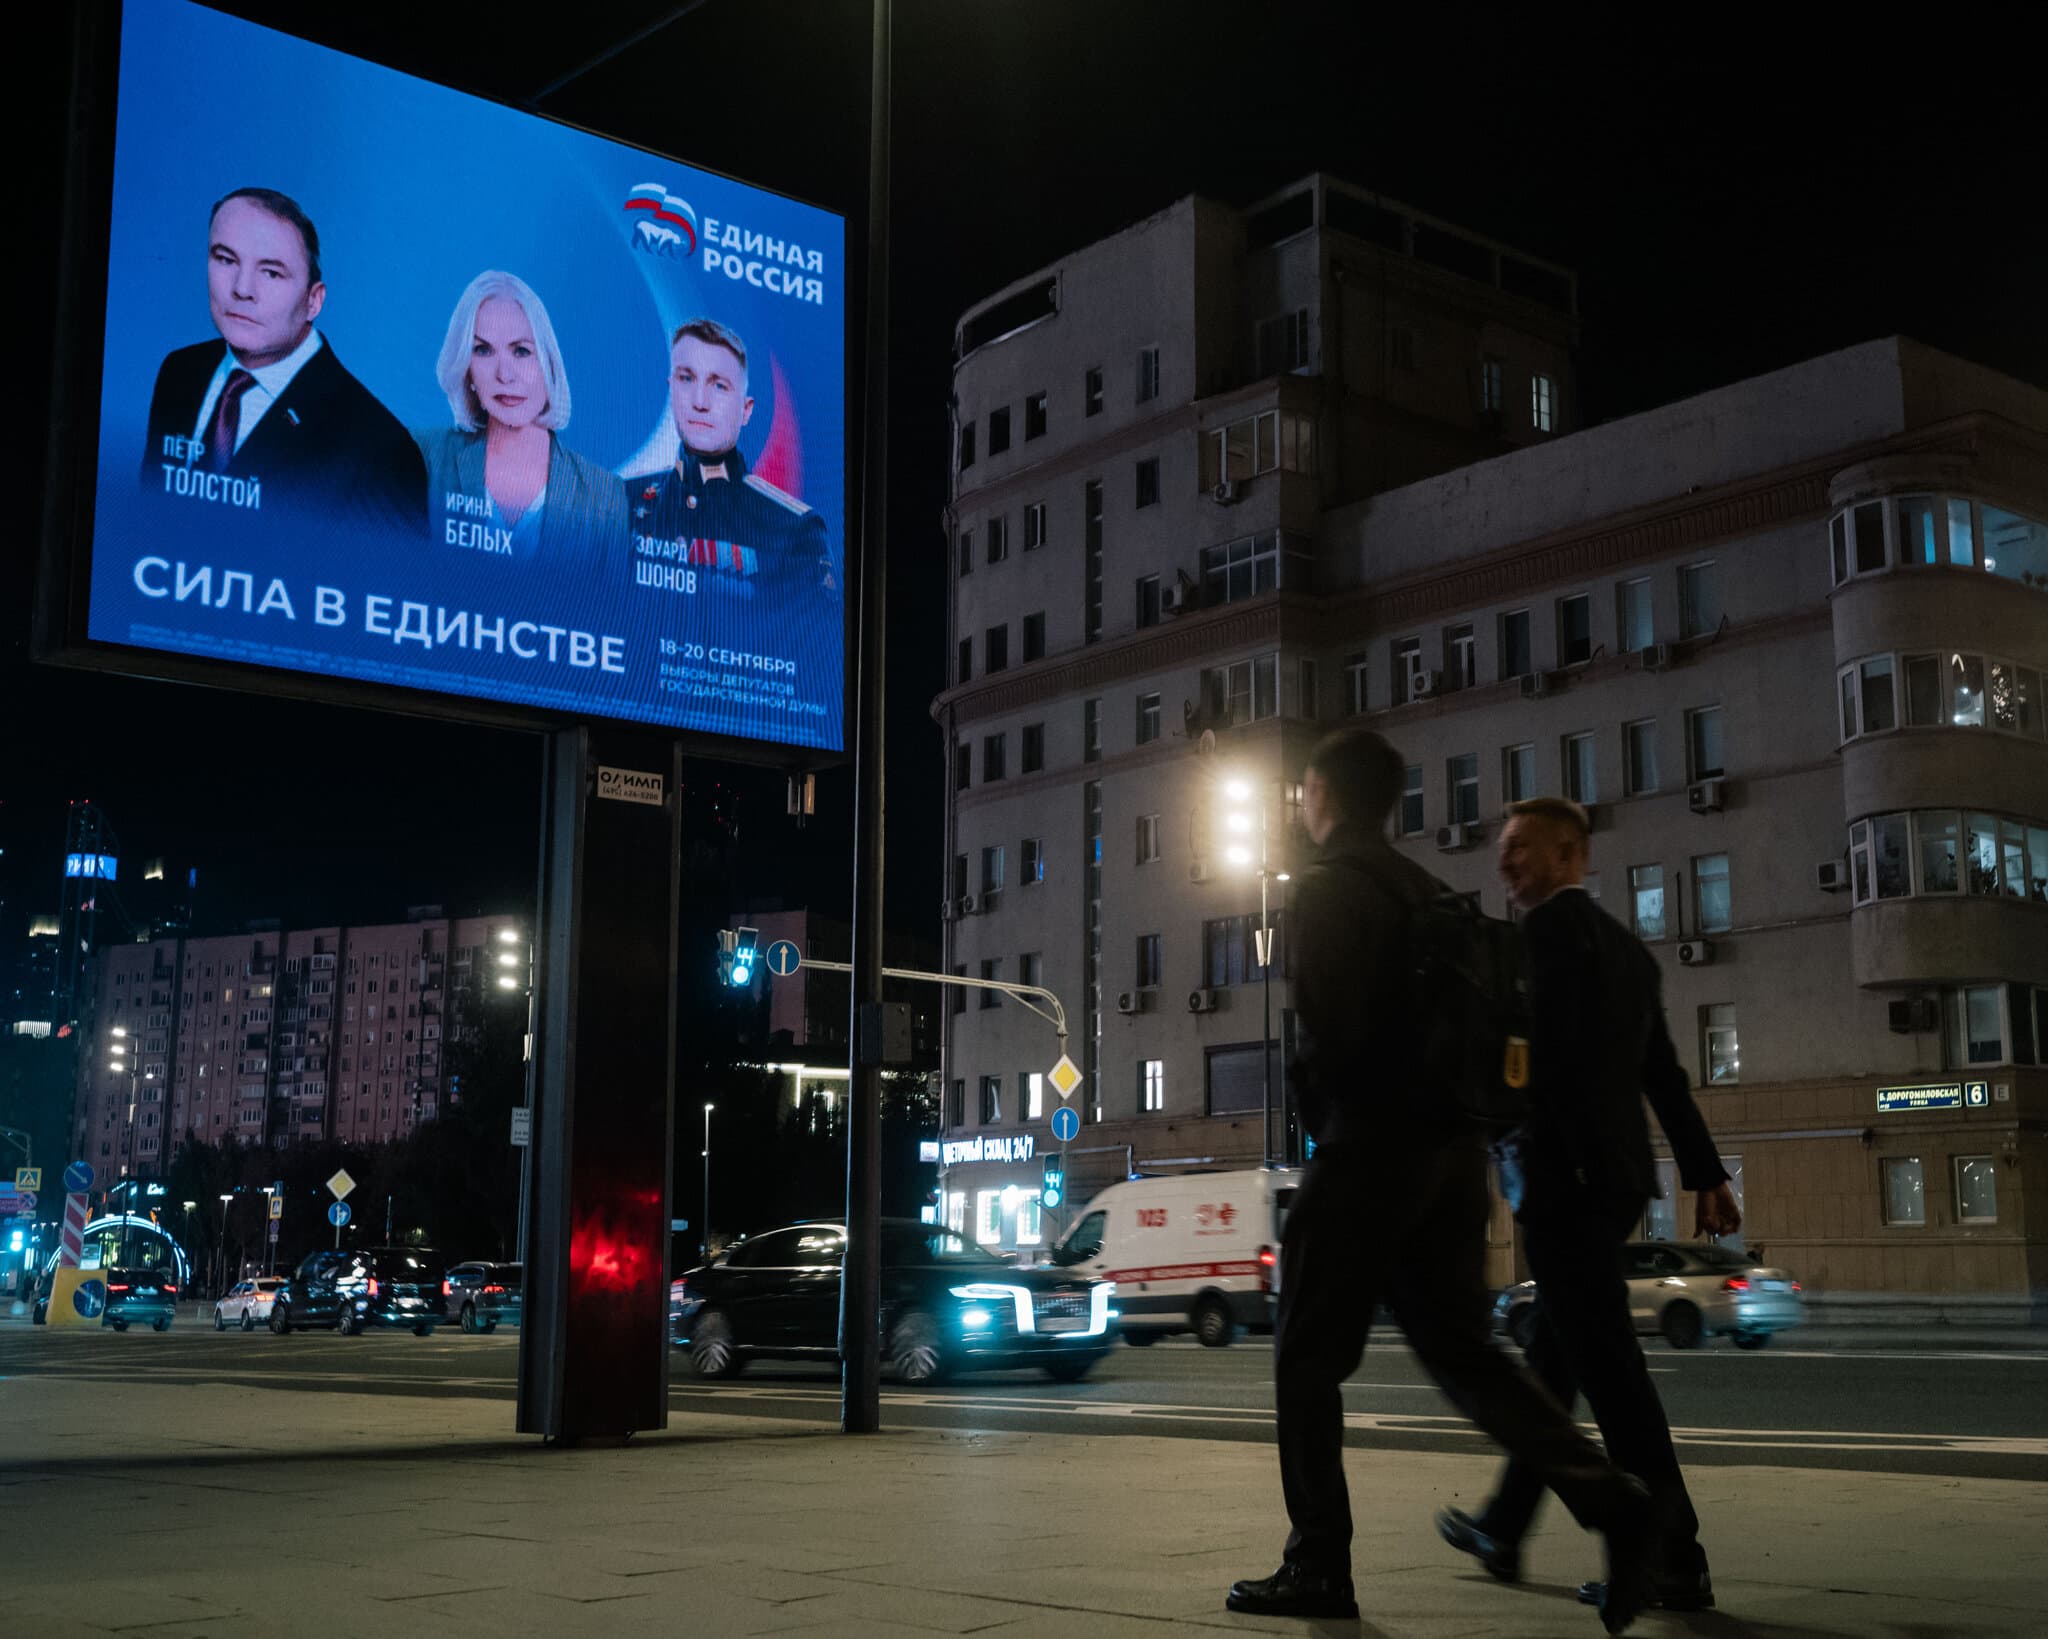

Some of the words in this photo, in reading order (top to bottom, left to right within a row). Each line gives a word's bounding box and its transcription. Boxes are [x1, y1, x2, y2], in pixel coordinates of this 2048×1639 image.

[704, 217, 823, 274] ЕДИНАЯ
[704, 247, 823, 305] РОССИЯ
[163, 433, 206, 462] ПЁТР
[162, 463, 261, 510] ТОЛСТОЙ
[446, 491, 493, 518] ИРИНА
[446, 518, 513, 556] БЕЛЫХ
[637, 560, 697, 594] ШОНОВ
[133, 556, 296, 620] СИЛА
[314, 585, 346, 627] В
[365, 594, 626, 673] ЕДИНСТВЕ
[708, 647, 796, 676] СЕНТЯБРЯ
[660, 663, 718, 684] ВЫБОРЫ
[721, 673, 794, 696] ДЕПУТАТОВ
[660, 679, 786, 709] ГОСУДАРСТВЕННОЙ
[788, 699, 827, 716] ДУМЫ
[1887, 1087, 1959, 1102] ДОРОГОМИЛОВСКАЯ
[1970, 1085, 1983, 1104] 6
[1013, 1134, 1034, 1162] 24/7
